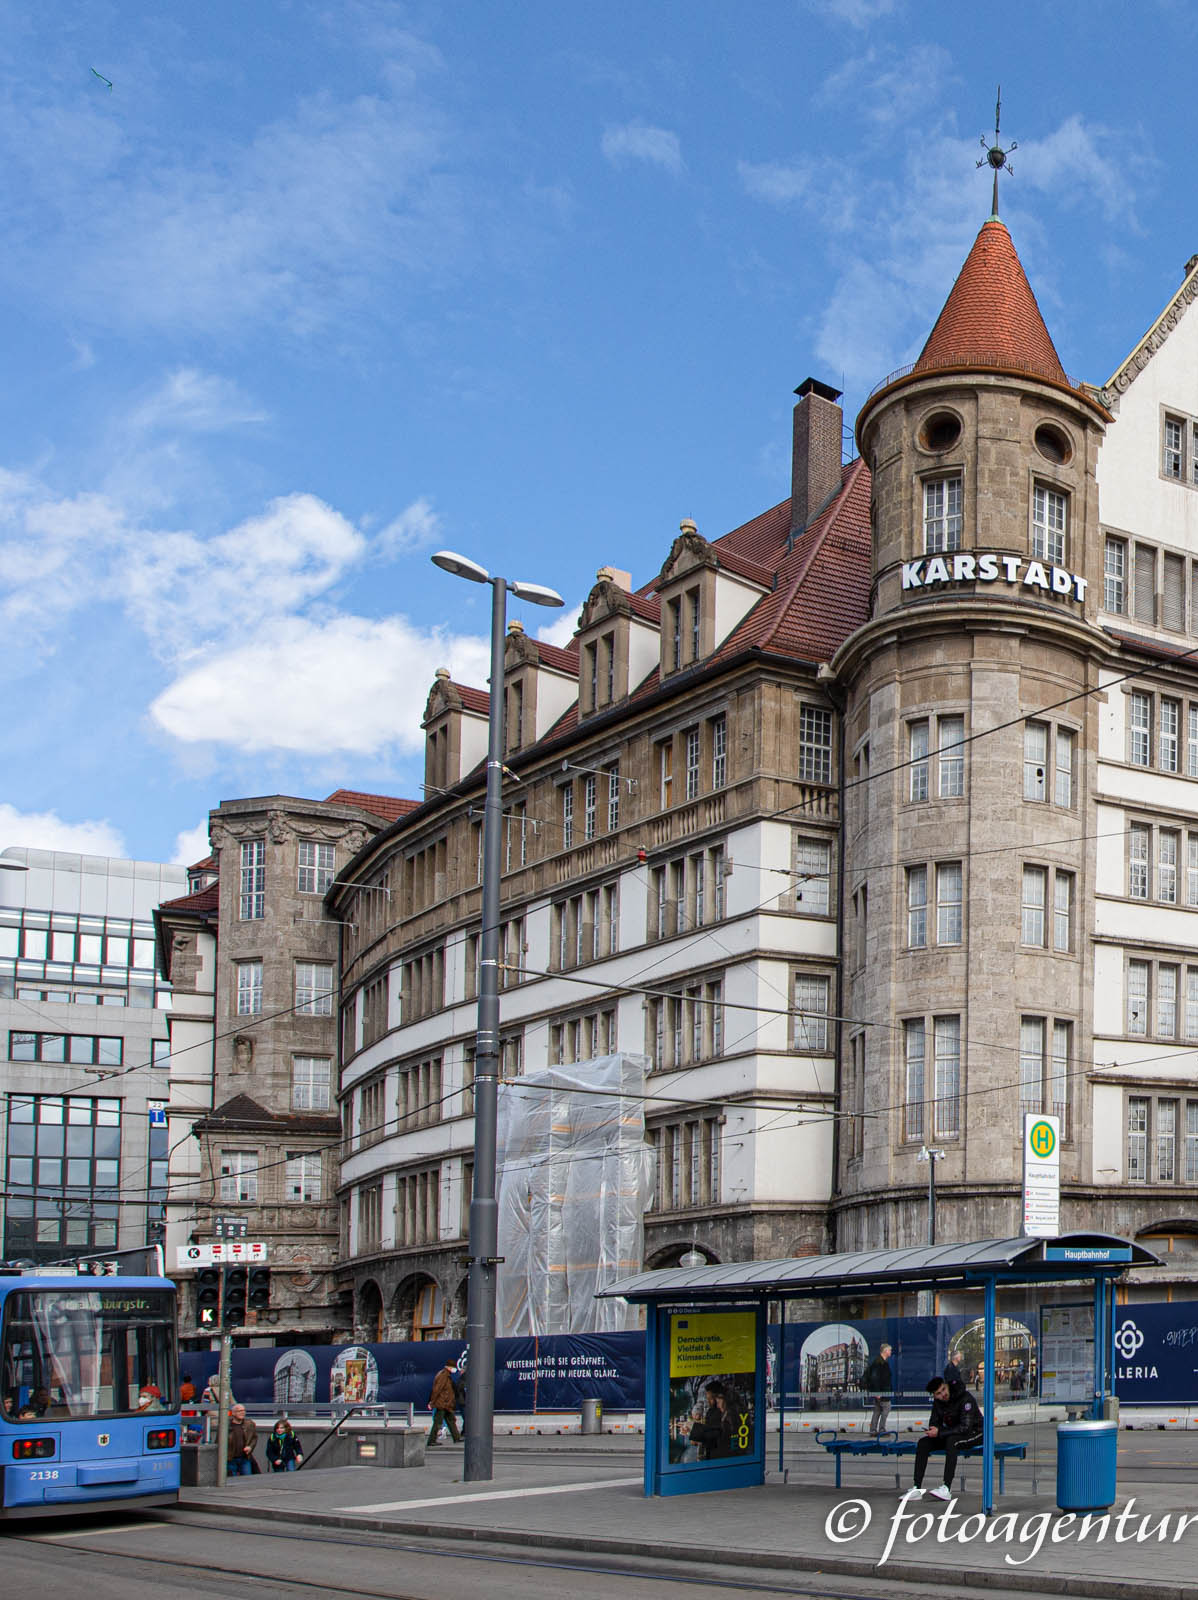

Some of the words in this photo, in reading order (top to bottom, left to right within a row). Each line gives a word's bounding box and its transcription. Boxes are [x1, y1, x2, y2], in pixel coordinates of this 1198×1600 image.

[902, 555, 1088, 603] KARSTADT
[1037, 1129, 1049, 1150] H
[1064, 1250, 1110, 1260] Hauptbahnhof
[202, 1309, 213, 1322] K
[506, 1356, 542, 1369] WEITERHIN
[543, 1355, 556, 1366] FÜR
[558, 1356, 569, 1365] SIE
[570, 1354, 607, 1366] GEÖFFNET.
[518, 1369, 556, 1381] ZUKÜNFTIG
[558, 1369, 566, 1378] IN
[568, 1369, 592, 1378] NEUEM
[594, 1369, 620, 1378] GLANZ.
[1104, 1366, 1159, 1379] LERIA
[738, 1413, 749, 1449] YOU
[29, 1470, 59, 1481] 2138
